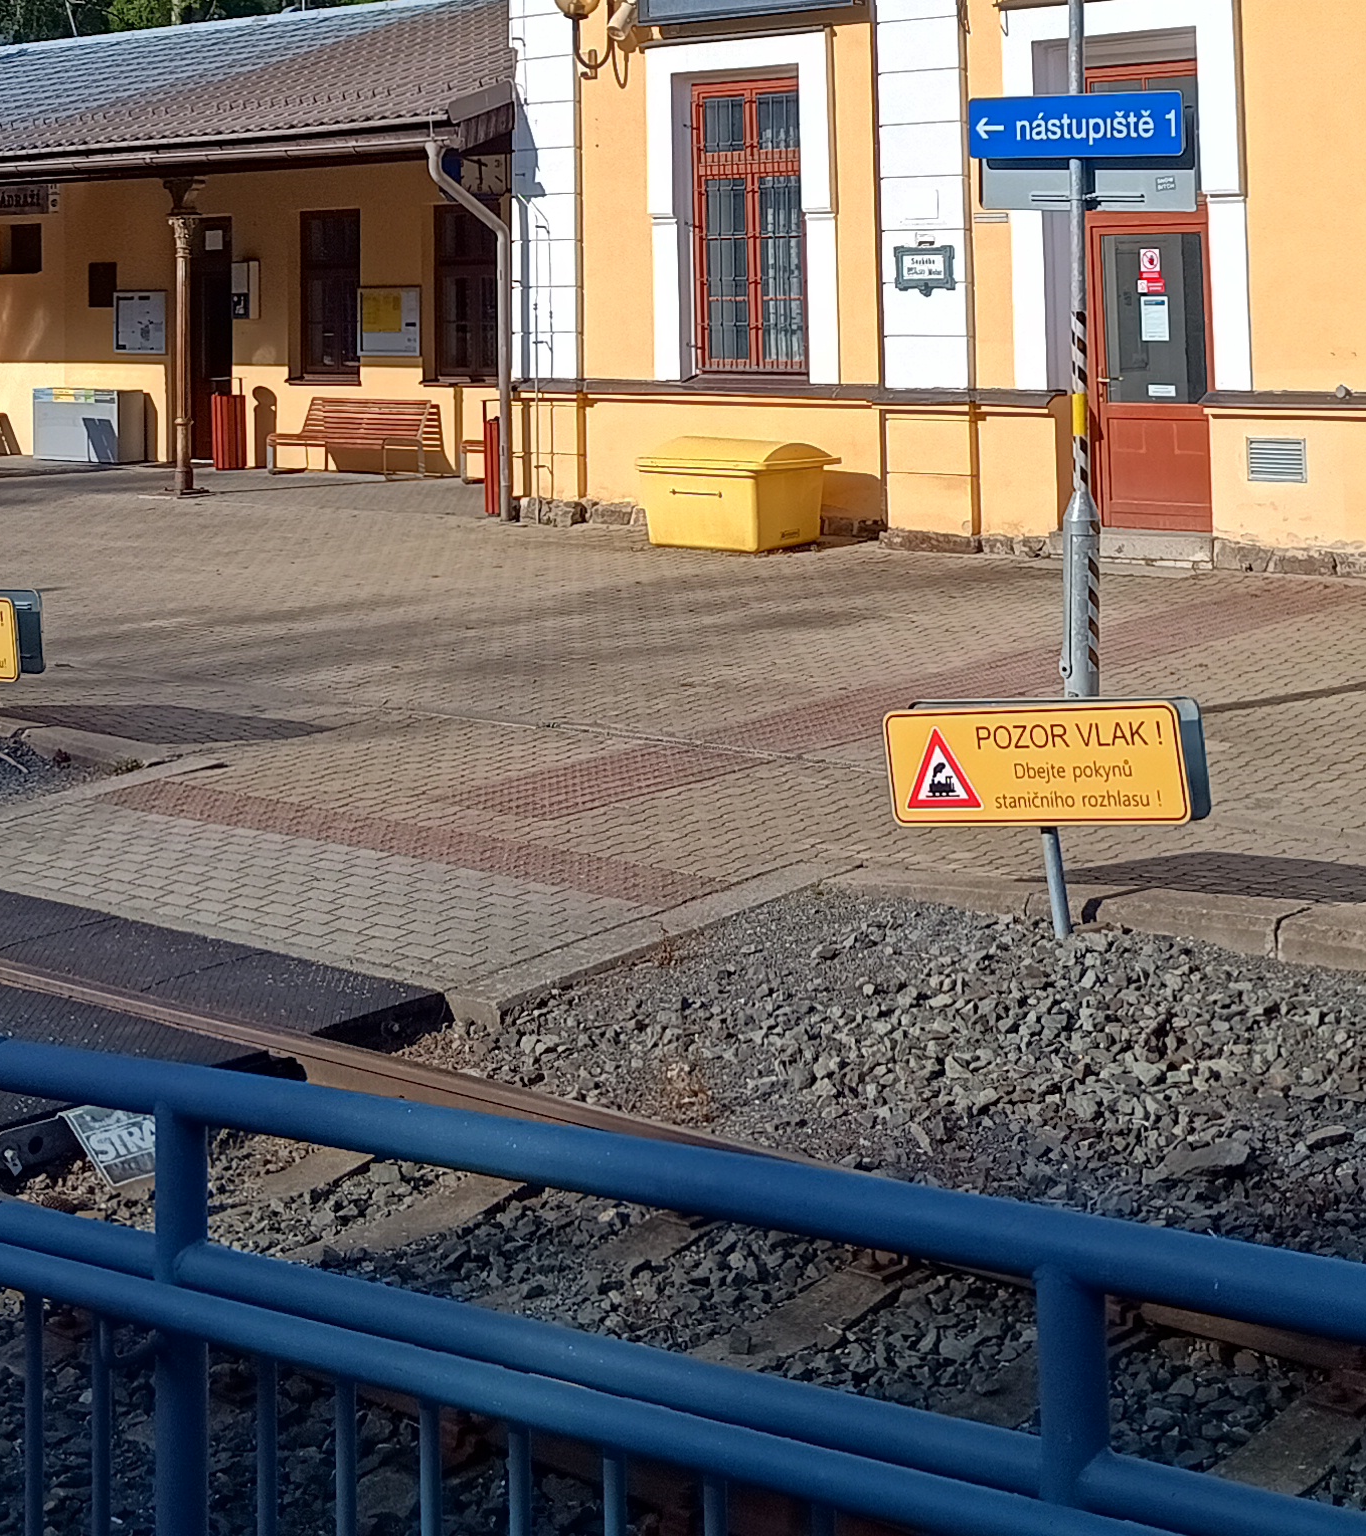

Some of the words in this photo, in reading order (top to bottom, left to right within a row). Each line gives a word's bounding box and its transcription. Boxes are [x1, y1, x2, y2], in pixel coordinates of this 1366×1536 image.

[1165, 109, 1176, 137] 1
[0, 610, 4, 626] !
[976, 723, 1070, 750] POZOR
[1075, 721, 1149, 747] VLAK
[1156, 720, 1163, 745] !
[1014, 762, 1066, 783] Dbejte
[1072, 759, 1133, 783] pokynů
[994, 790, 1075, 809] staničního
[1081, 790, 1150, 808] rozhlasu
[1157, 790, 1163, 806] !
